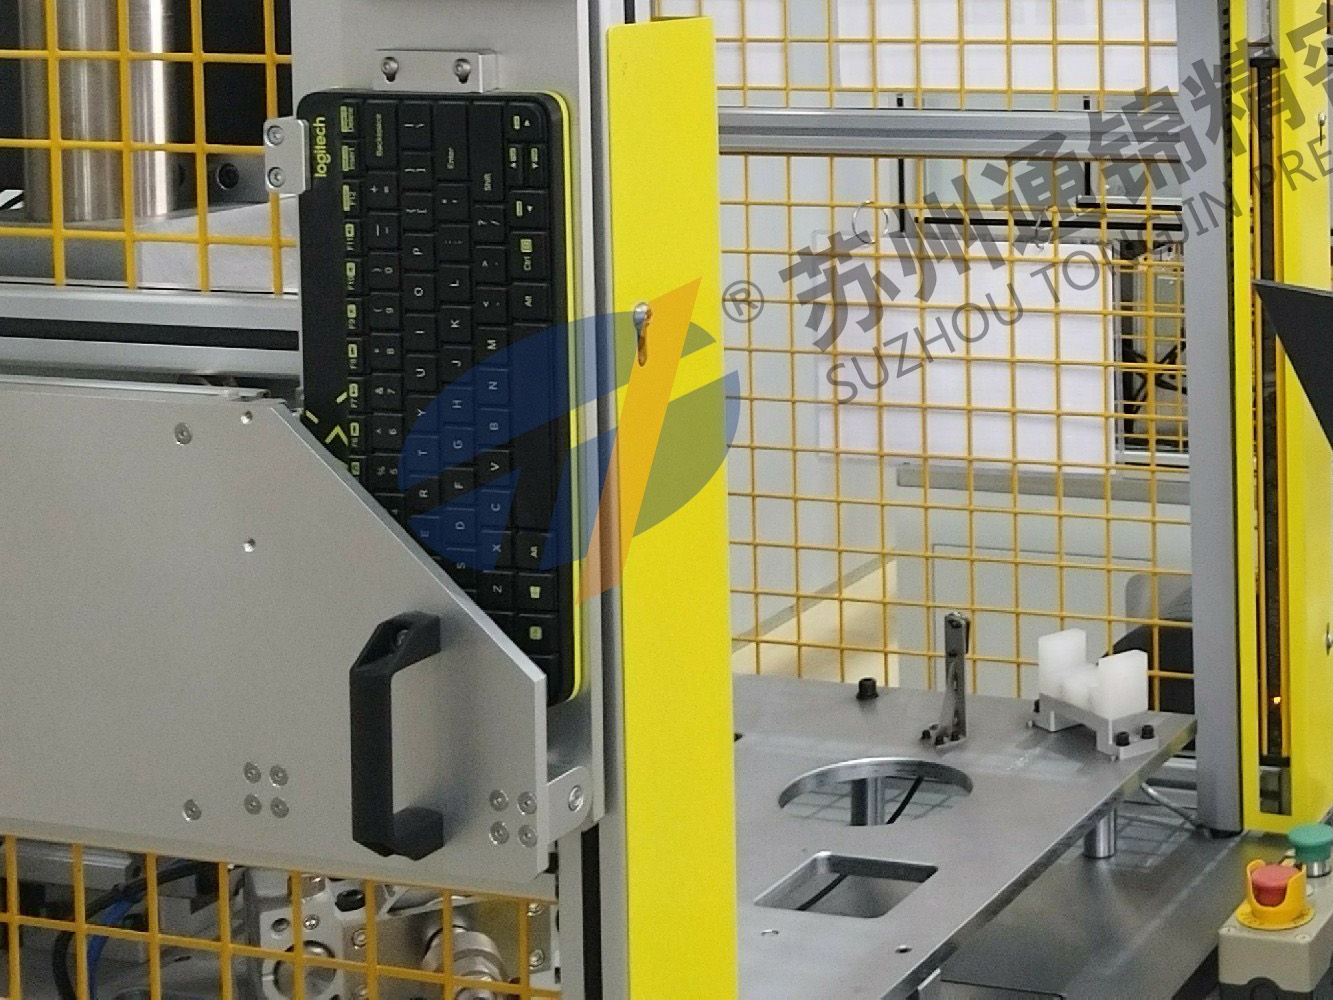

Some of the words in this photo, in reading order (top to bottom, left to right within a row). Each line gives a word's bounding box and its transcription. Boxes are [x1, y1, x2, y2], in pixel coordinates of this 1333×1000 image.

[313, 117, 331, 177] logitech
[412, 247, 423, 255] P
[450, 319, 460, 328] K
[487, 339, 496, 350] M
[416, 368, 426, 377] U
[489, 381, 498, 390] N
[452, 400, 462, 408] H
[417, 408, 426, 417] Y
[489, 422, 499, 430] B
[453, 440, 463, 448] G
[490, 462, 500, 471] V
[491, 503, 500, 511] C
[455, 521, 466, 530] D
[492, 544, 501, 553] X
[493, 585, 502, 593] Z
